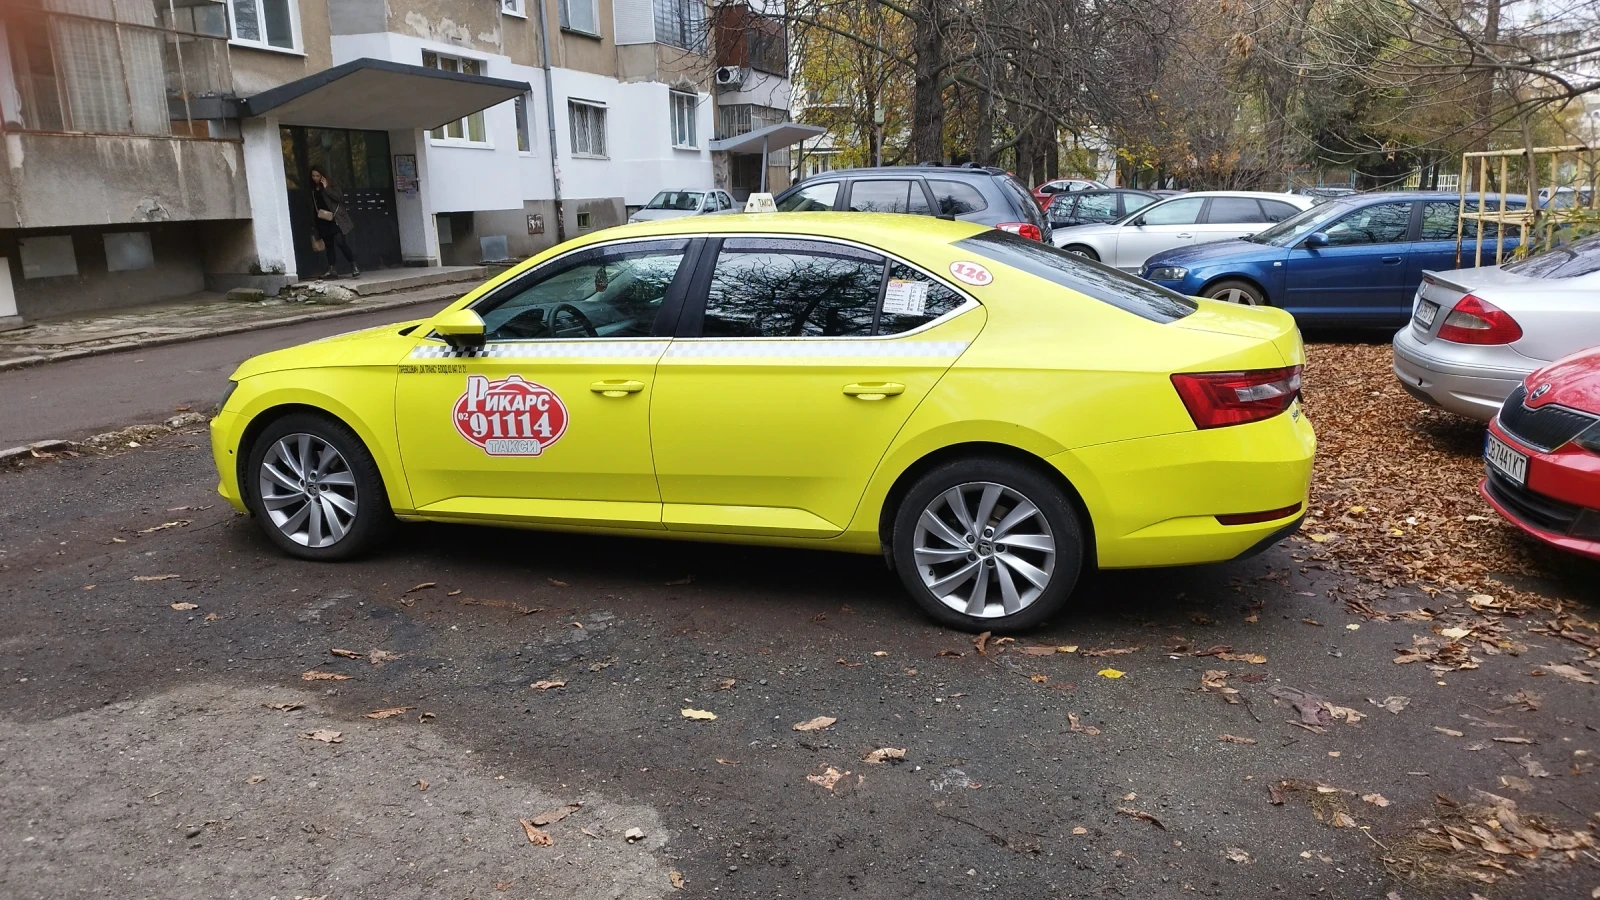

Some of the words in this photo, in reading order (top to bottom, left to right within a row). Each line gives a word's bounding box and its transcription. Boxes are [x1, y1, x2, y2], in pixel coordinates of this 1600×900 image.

[757, 198, 773, 207] ТАКСИ
[953, 263, 987, 282] 126
[458, 412, 469, 420] 02
[469, 412, 552, 437] 91114
[489, 440, 538, 453] ТАКСИ
